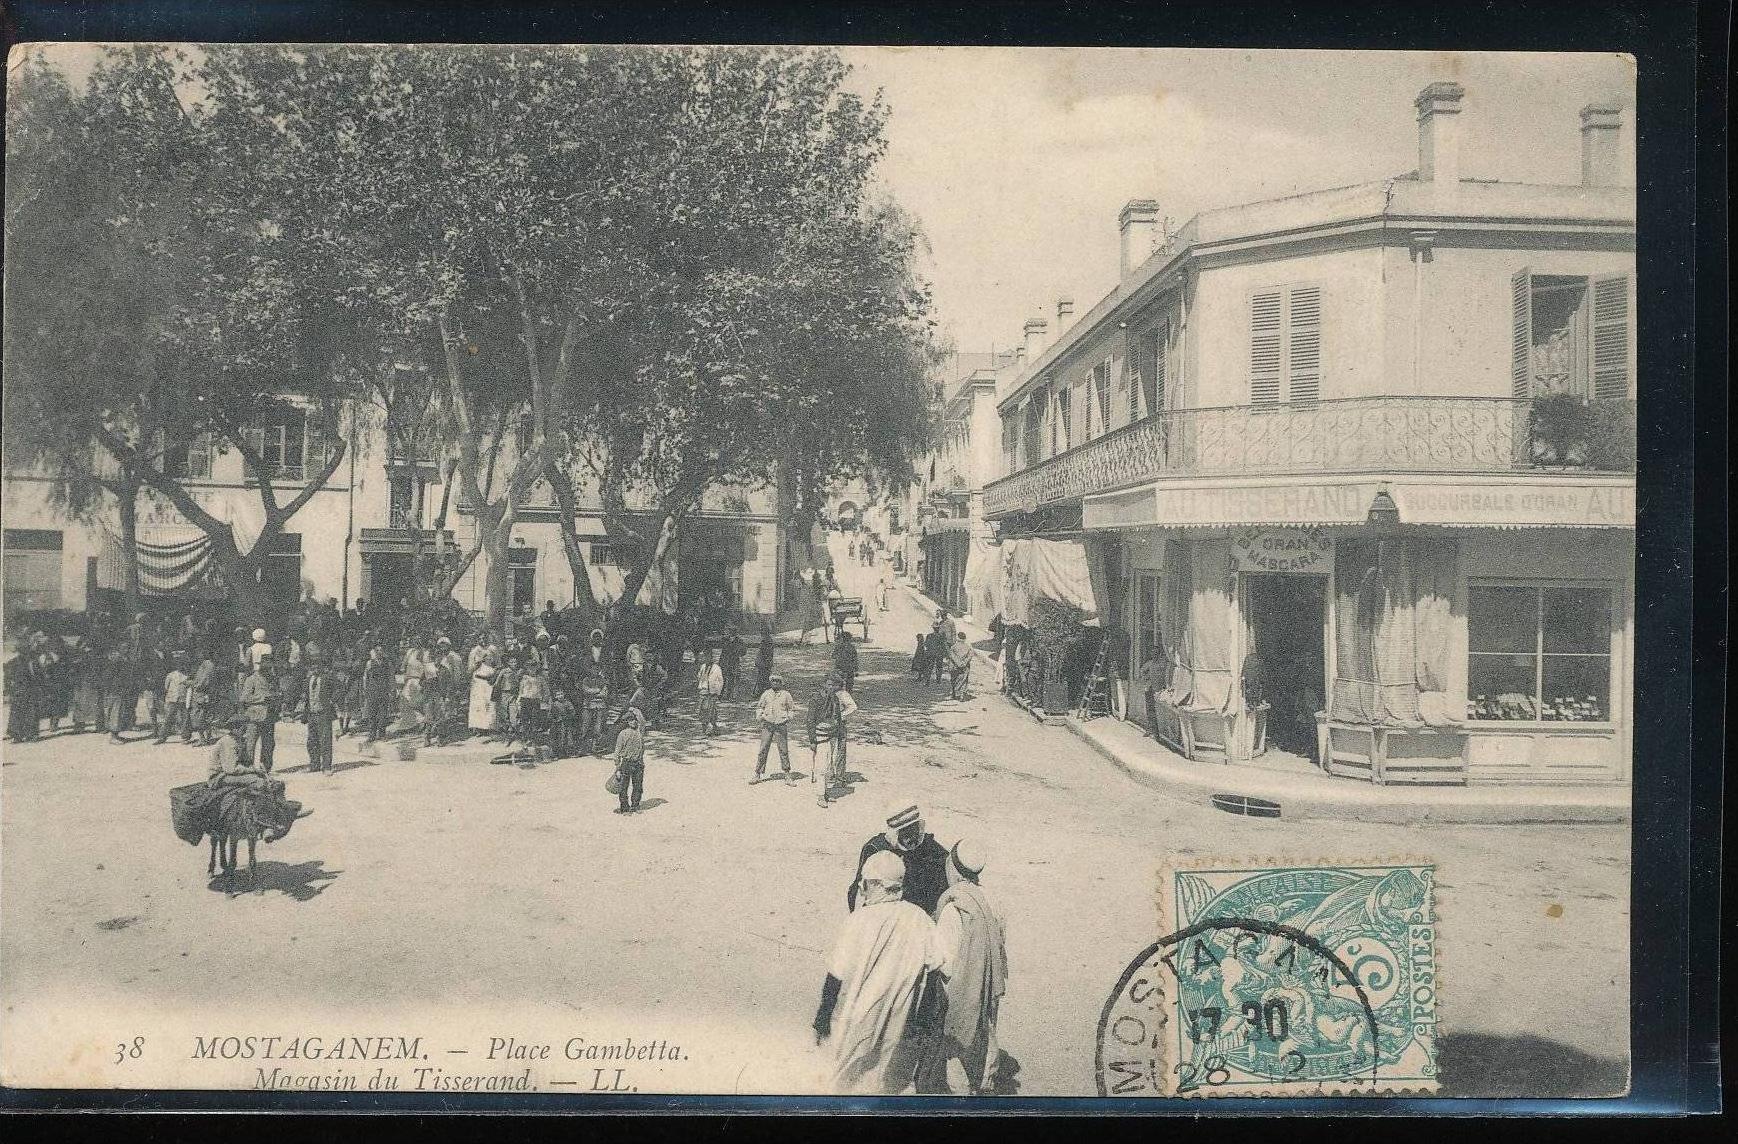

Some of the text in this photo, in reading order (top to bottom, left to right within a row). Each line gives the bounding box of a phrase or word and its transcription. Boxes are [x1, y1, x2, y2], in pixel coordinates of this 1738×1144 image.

[1586, 487, 1625, 521] AU
[1262, 537, 1309, 551] ORAN
[1411, 927, 1434, 1019] POSTES
[1173, 1055, 1231, 1093] 28
